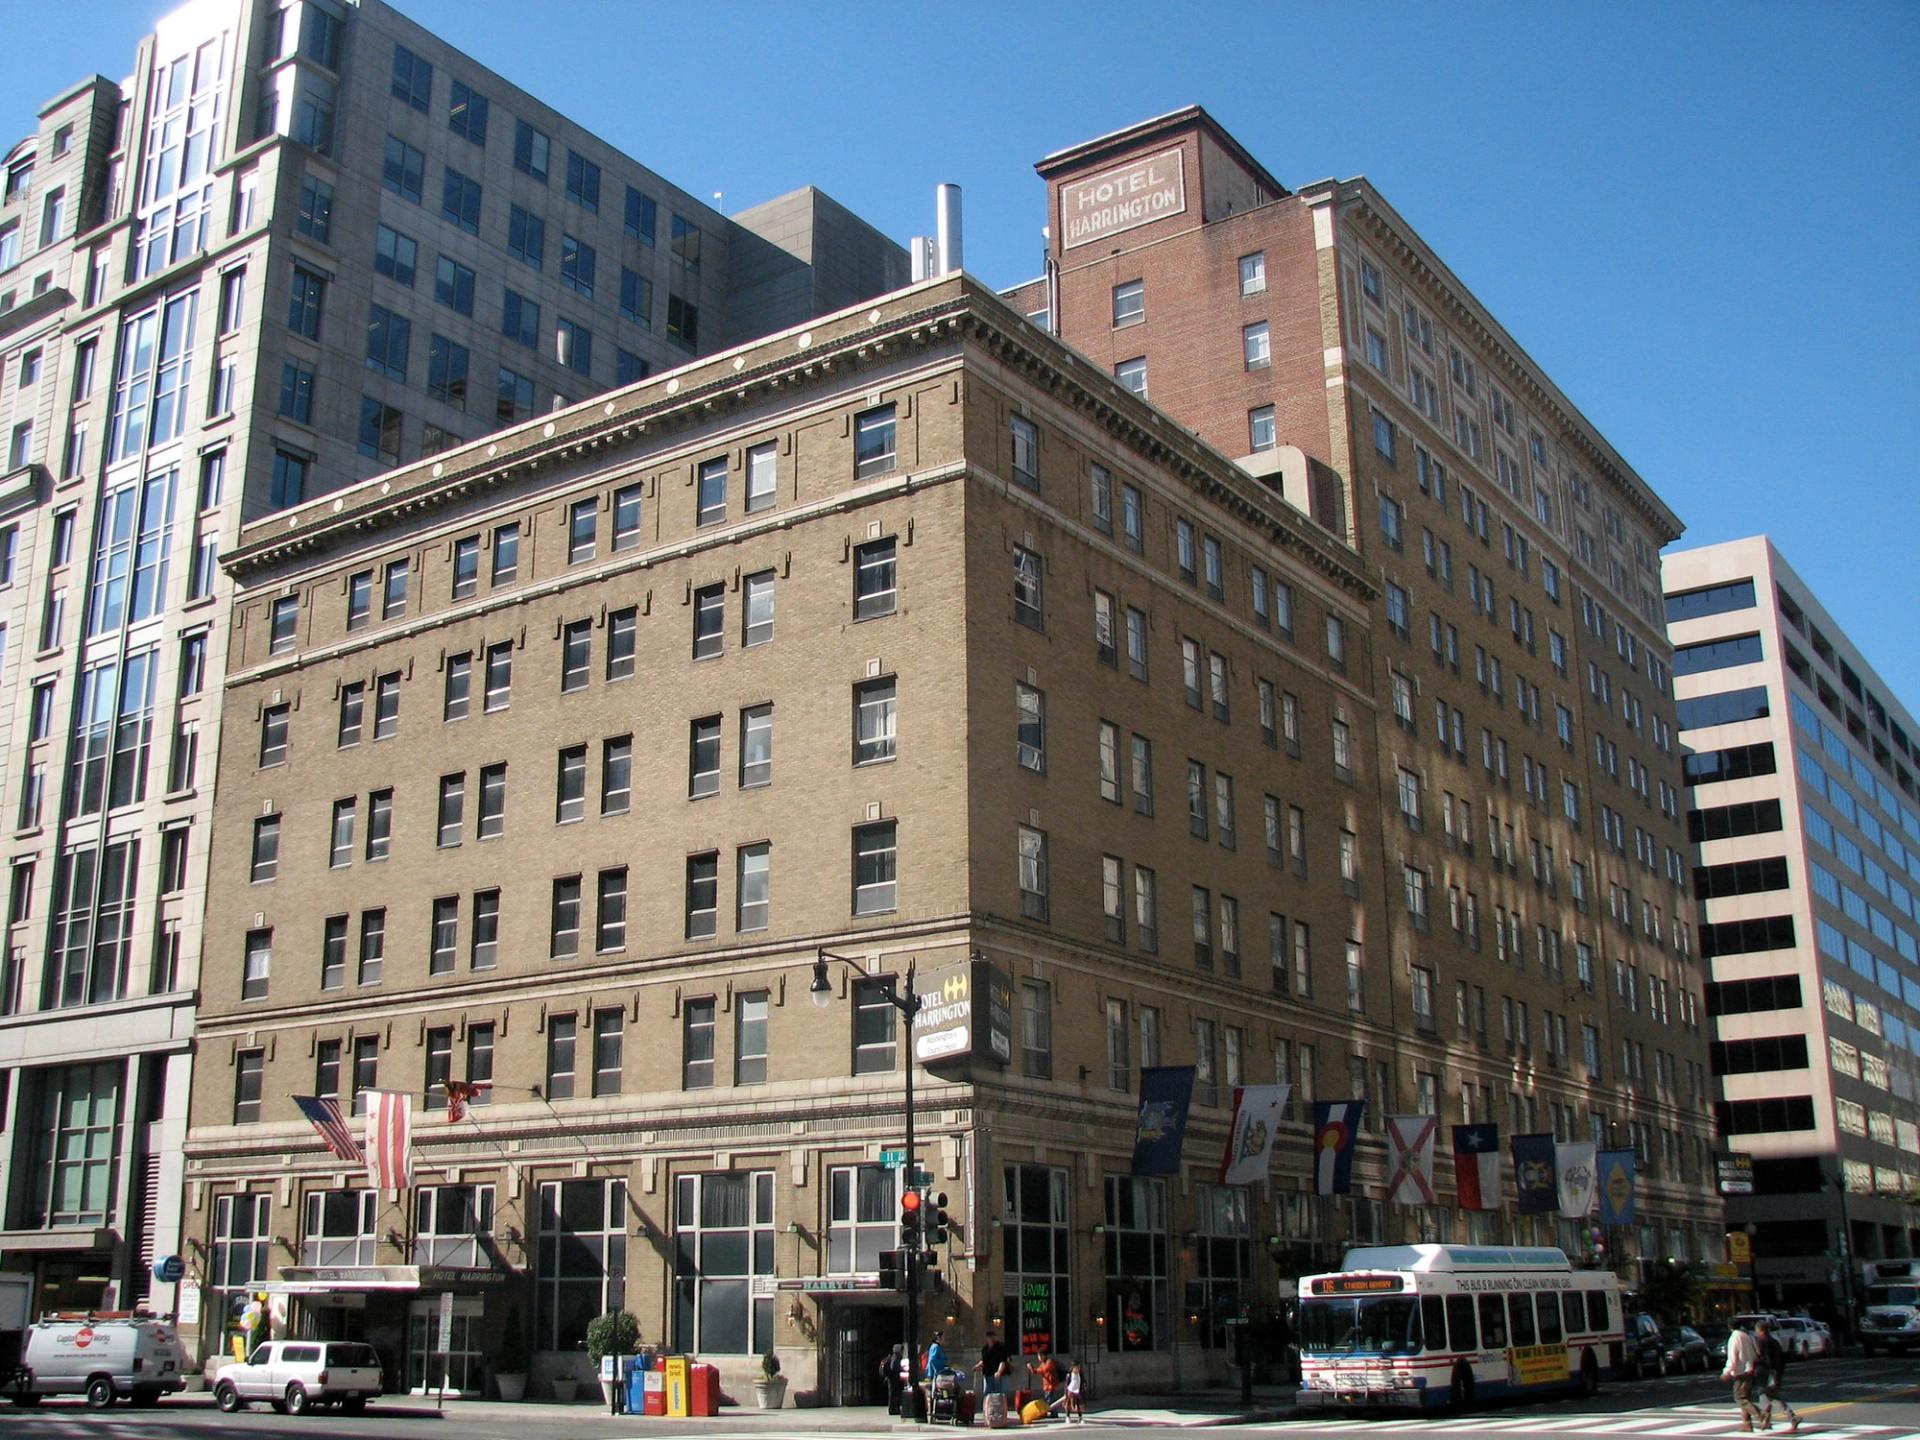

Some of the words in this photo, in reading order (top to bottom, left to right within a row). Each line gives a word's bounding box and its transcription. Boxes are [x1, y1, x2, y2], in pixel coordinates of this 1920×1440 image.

[1078, 167, 1165, 210] HOTEL
[1069, 186, 1176, 239] HARRINGTON
[916, 990, 944, 1012] OTEL
[914, 1000, 971, 1029] HARRINGTON
[433, 1271, 457, 1282] HOTEL
[461, 1271, 506, 1283] HARRINGTON
[803, 1281, 854, 1290] HARRY'S
[1456, 1279, 1470, 1291] THIS
[1470, 1280, 1482, 1291] BUS
[1482, 1280, 1488, 1290] IS
[1487, 1279, 1513, 1290] RUNNING
[1513, 1278, 1523, 1290] ON
[1523, 1279, 1540, 1289] CLEAN
[1540, 1279, 1561, 1289] NATURAL
